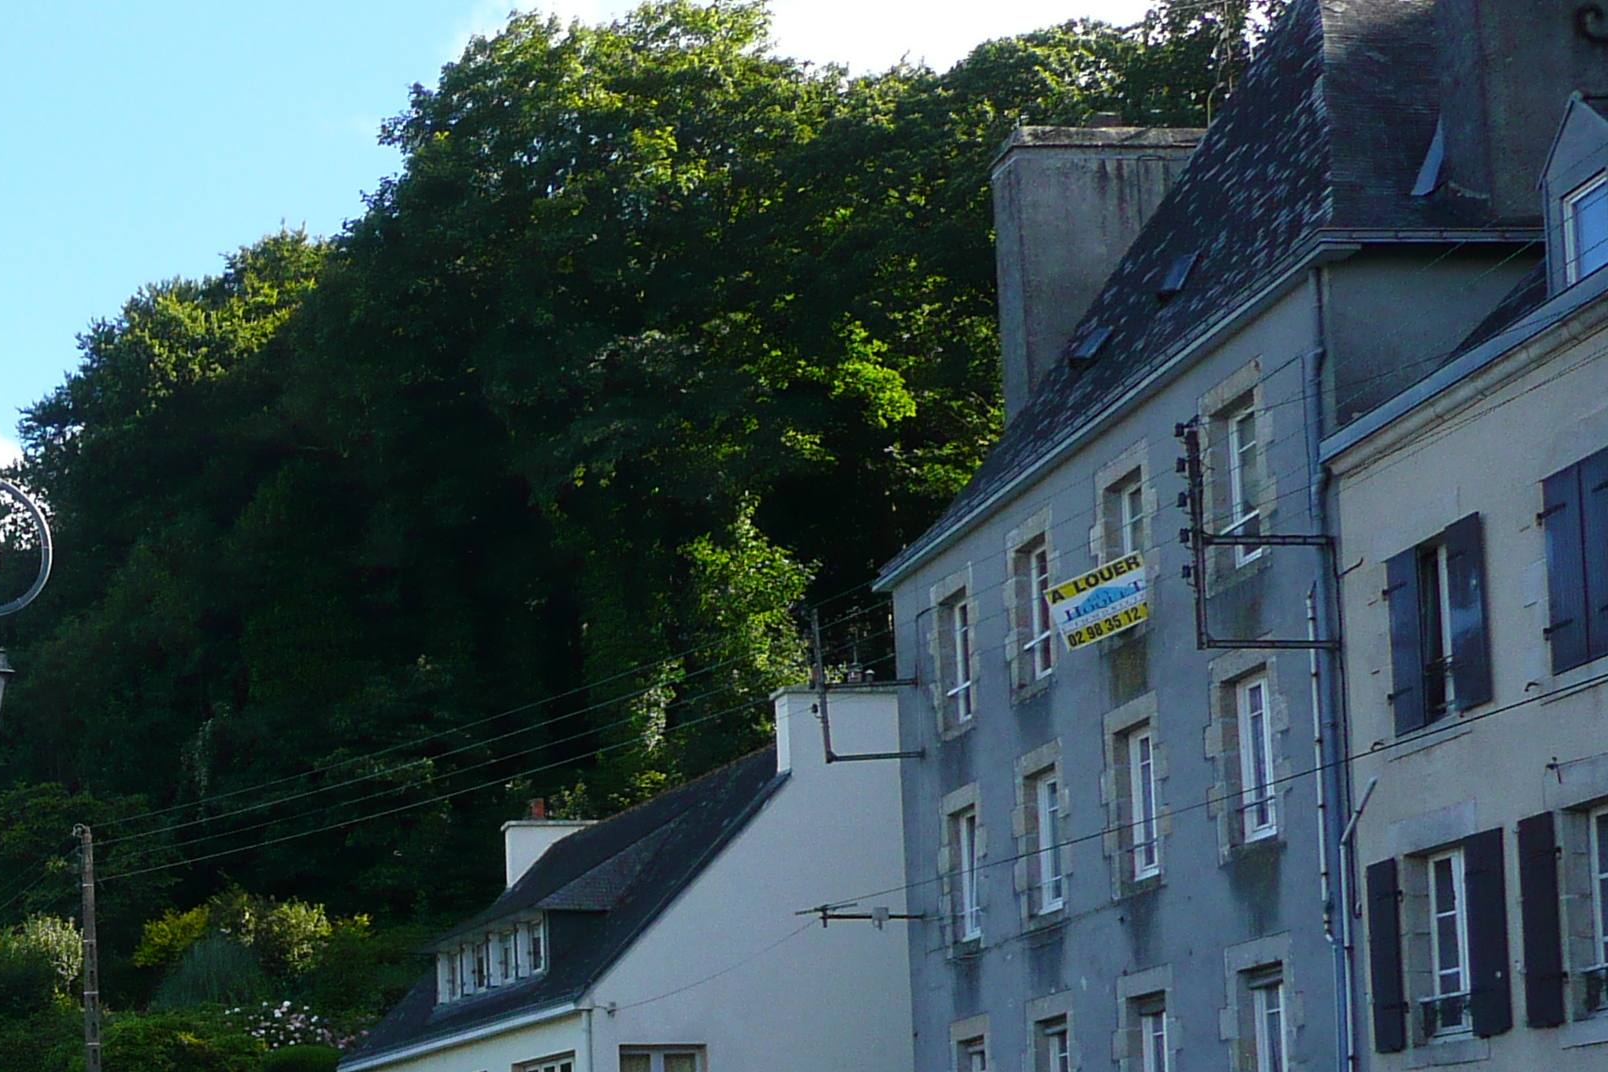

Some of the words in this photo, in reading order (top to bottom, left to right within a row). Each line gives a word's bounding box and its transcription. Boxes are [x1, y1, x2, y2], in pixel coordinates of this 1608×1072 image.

[1051, 589, 1066, 604] A
[1072, 555, 1141, 594] LOUER
[1067, 630, 1086, 648] 02
[1086, 622, 1104, 640] 98
[1104, 614, 1122, 632] 35
[1124, 606, 1142, 623] 12
